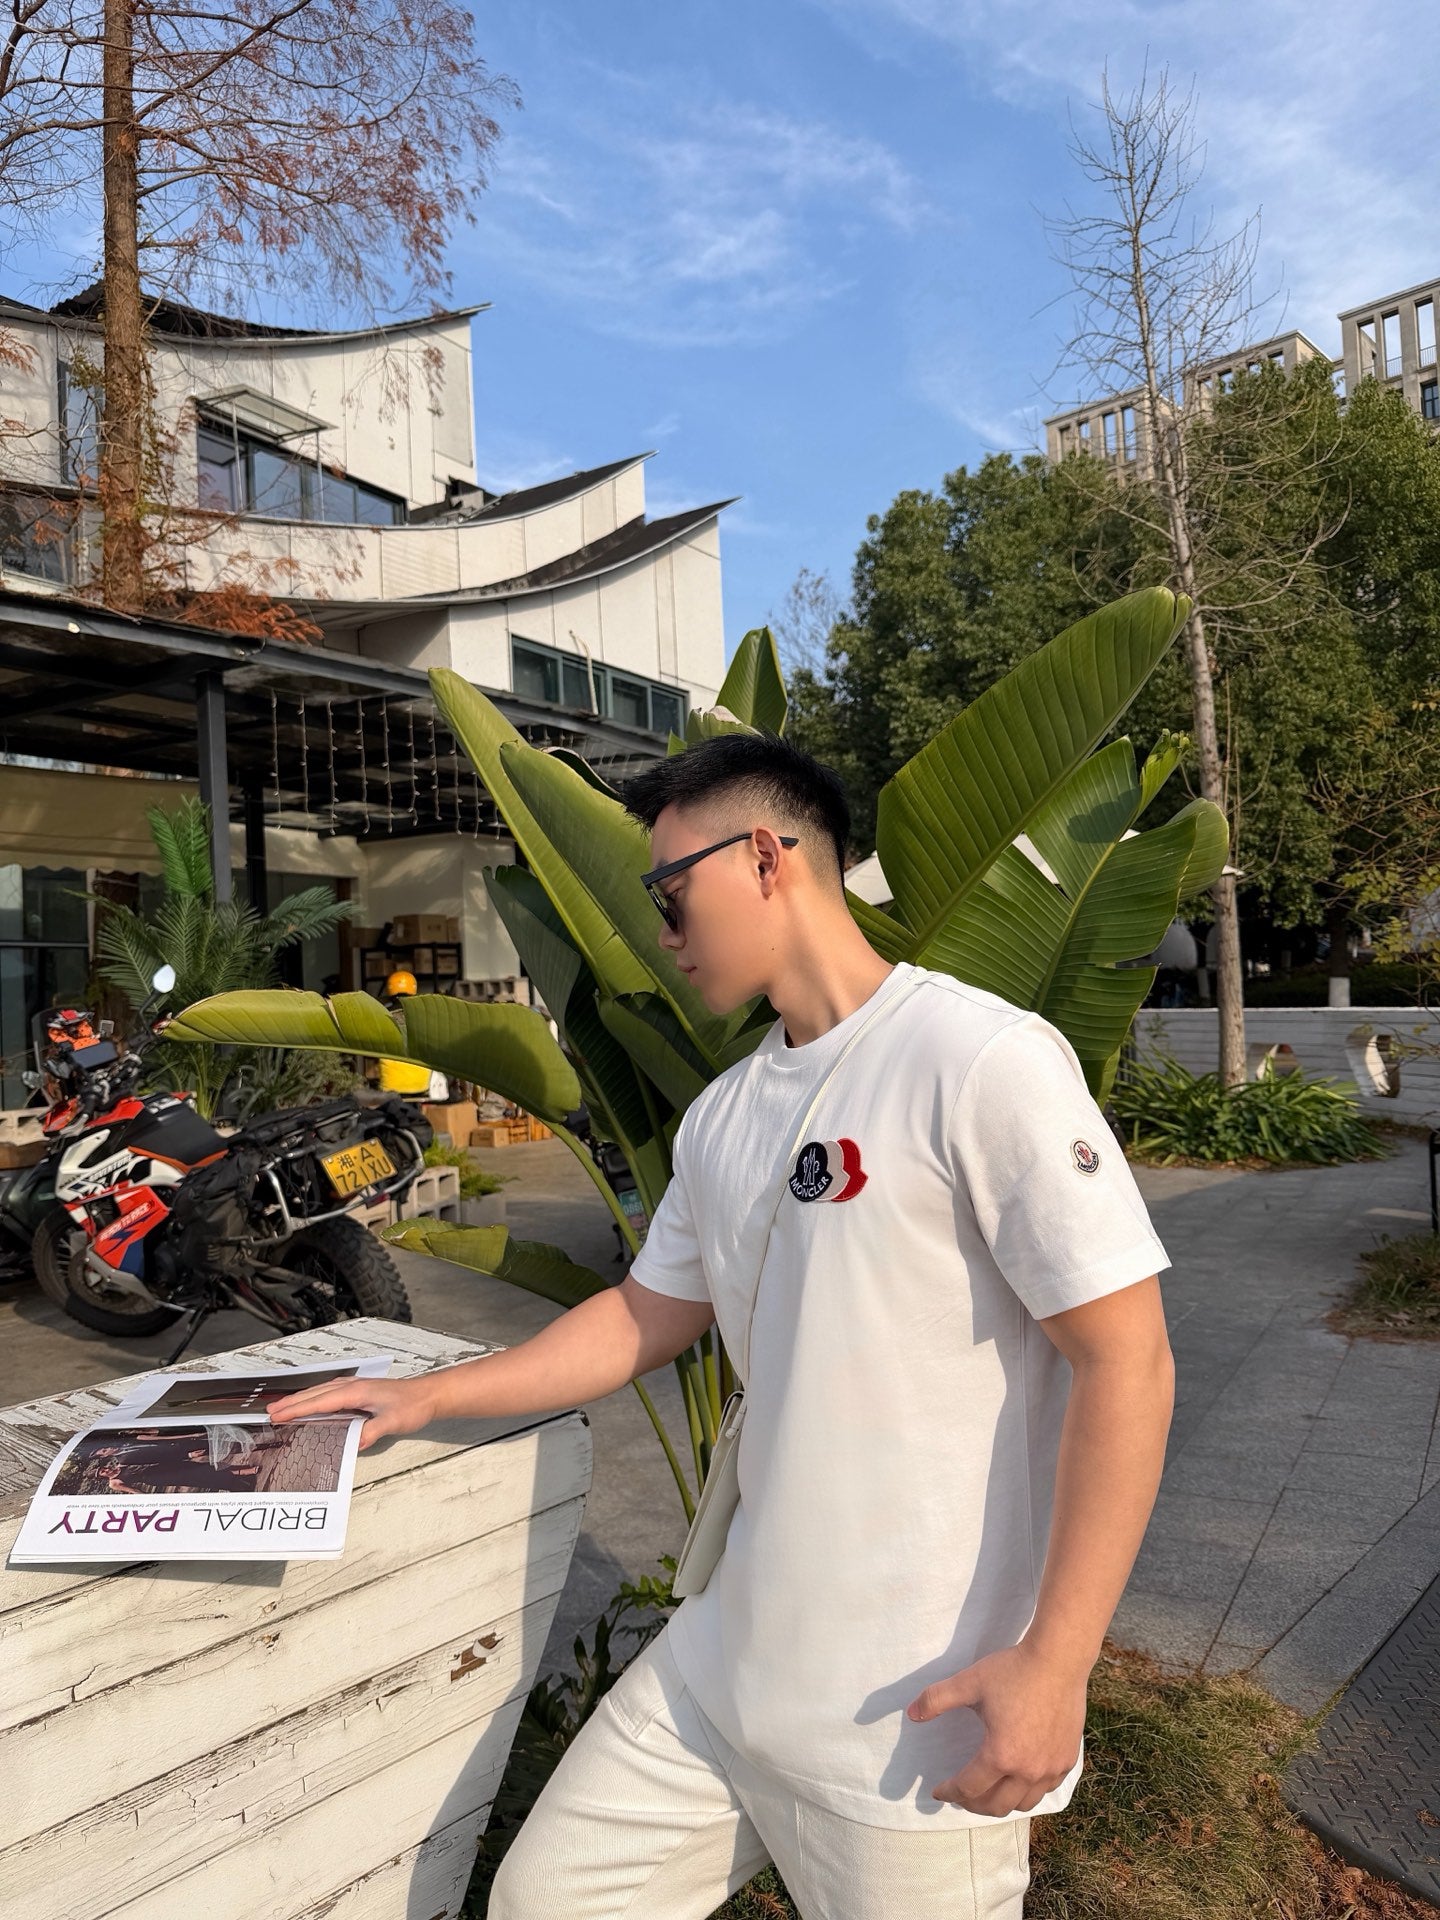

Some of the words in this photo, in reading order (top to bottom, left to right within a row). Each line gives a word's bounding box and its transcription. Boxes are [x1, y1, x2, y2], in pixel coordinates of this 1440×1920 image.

[336, 1156, 392, 1192] 721XU
[790, 1176, 830, 1198] MONCLER
[48, 1509, 180, 1534] PARTY
[194, 1508, 328, 1531] BRIDAL
